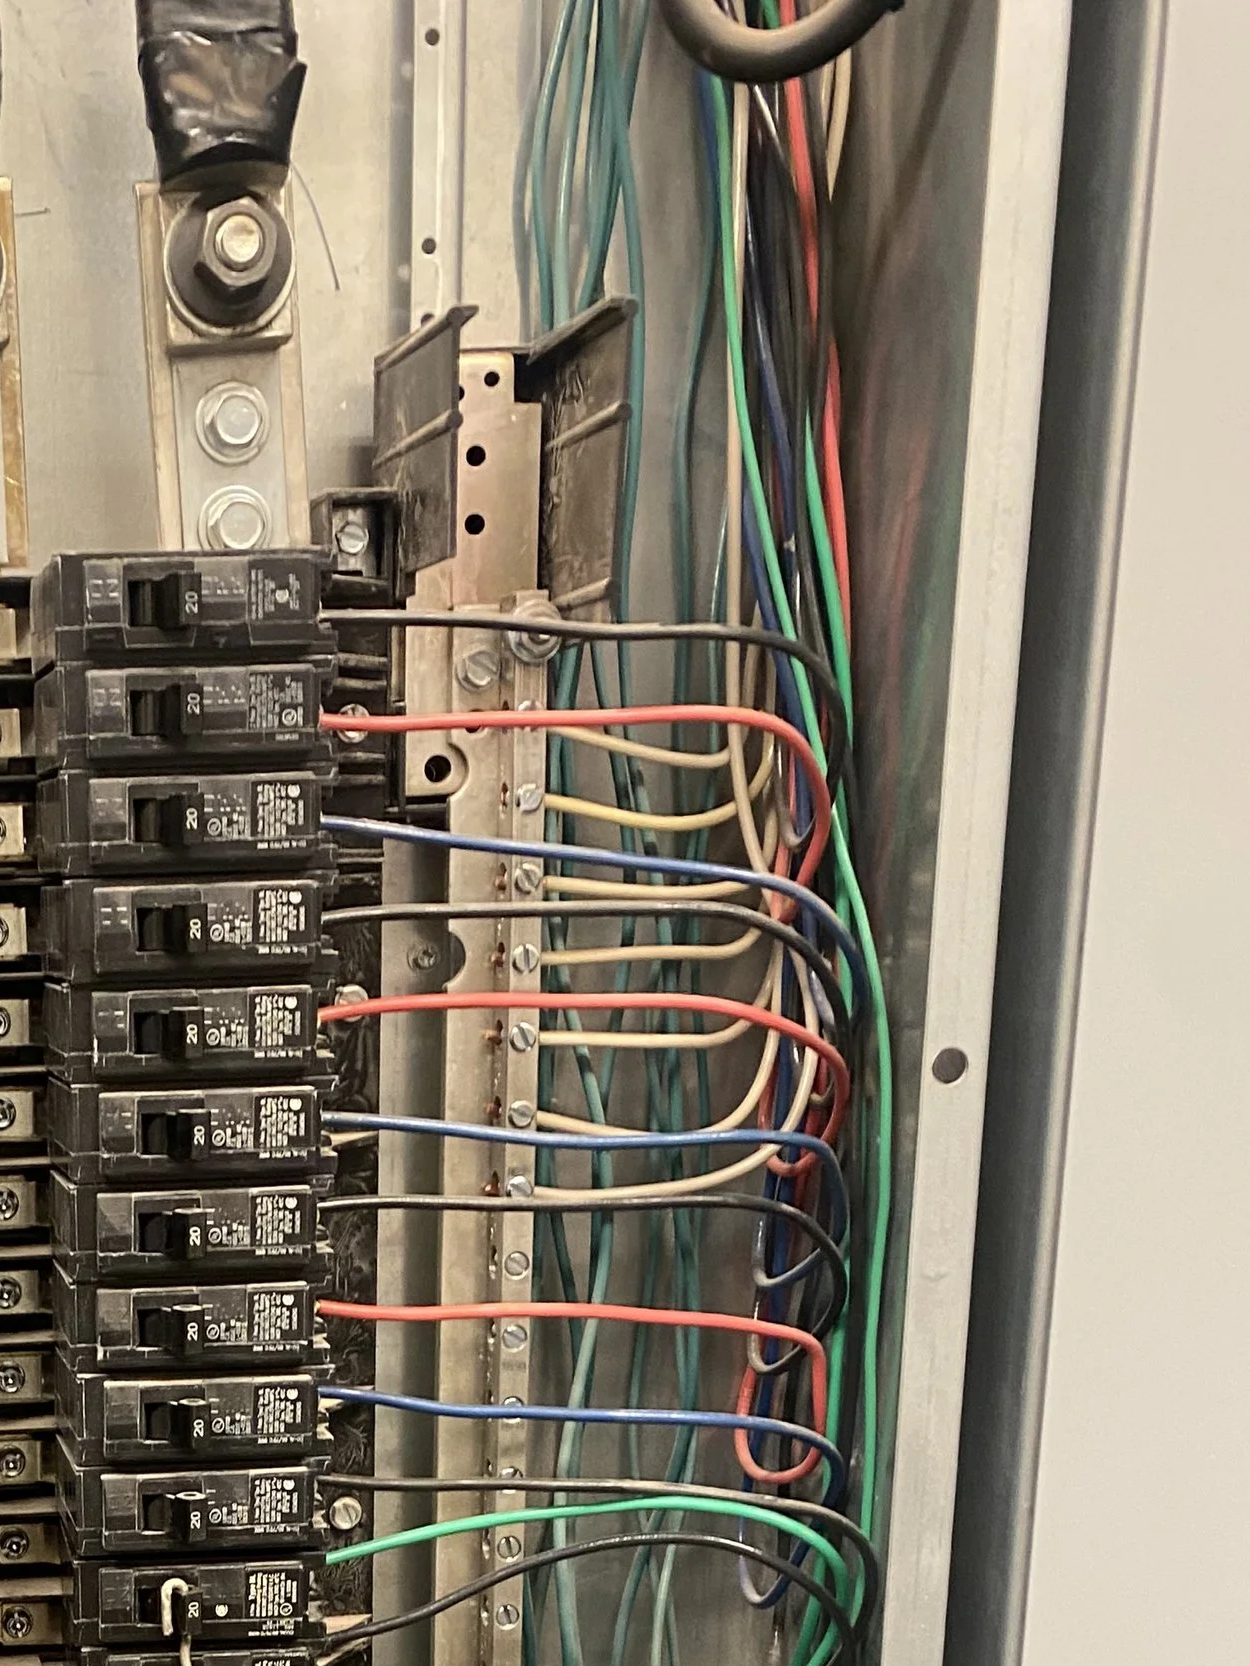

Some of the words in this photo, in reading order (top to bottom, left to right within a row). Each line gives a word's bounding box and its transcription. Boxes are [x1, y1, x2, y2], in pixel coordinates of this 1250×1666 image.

[185, 592, 199, 614] 20
[187, 693, 201, 715] 20
[186, 808, 198, 830] 20
[190, 919, 202, 940] 20
[187, 1024, 198, 1045] 20
[194, 1126, 205, 1146] 20
[190, 1227, 201, 1247] 20
[188, 1323, 199, 1342] 20
[194, 1420, 205, 1438] 20
[191, 1512, 201, 1530] 20
[188, 1602, 199, 1619] 20
